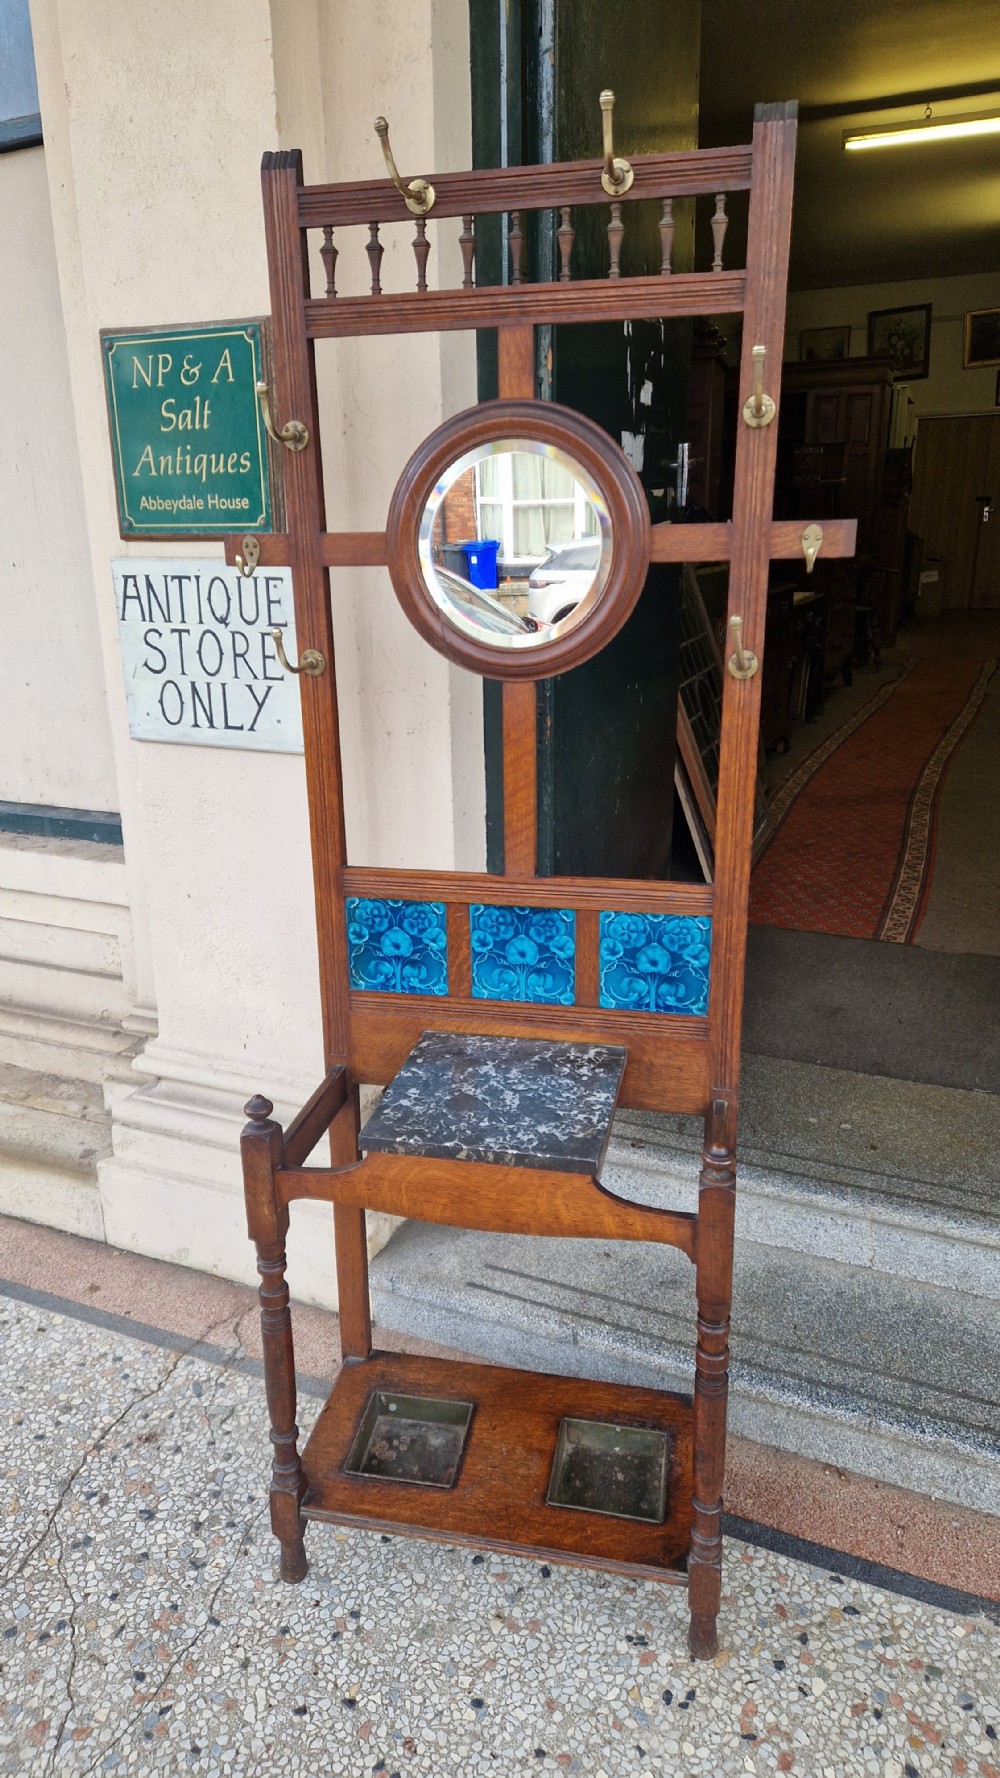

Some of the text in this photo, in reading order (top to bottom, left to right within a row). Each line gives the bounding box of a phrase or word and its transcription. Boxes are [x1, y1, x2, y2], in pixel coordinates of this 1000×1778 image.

[131, 348, 235, 388] NP & A
[160, 396, 211, 432] Salt
[132, 445, 251, 482] Antiques
[140, 494, 249, 514] Abbeydale House
[120, 574, 288, 628] ANTIQUE
[142, 628, 284, 681] STORE
[158, 680, 273, 731] ONLY
